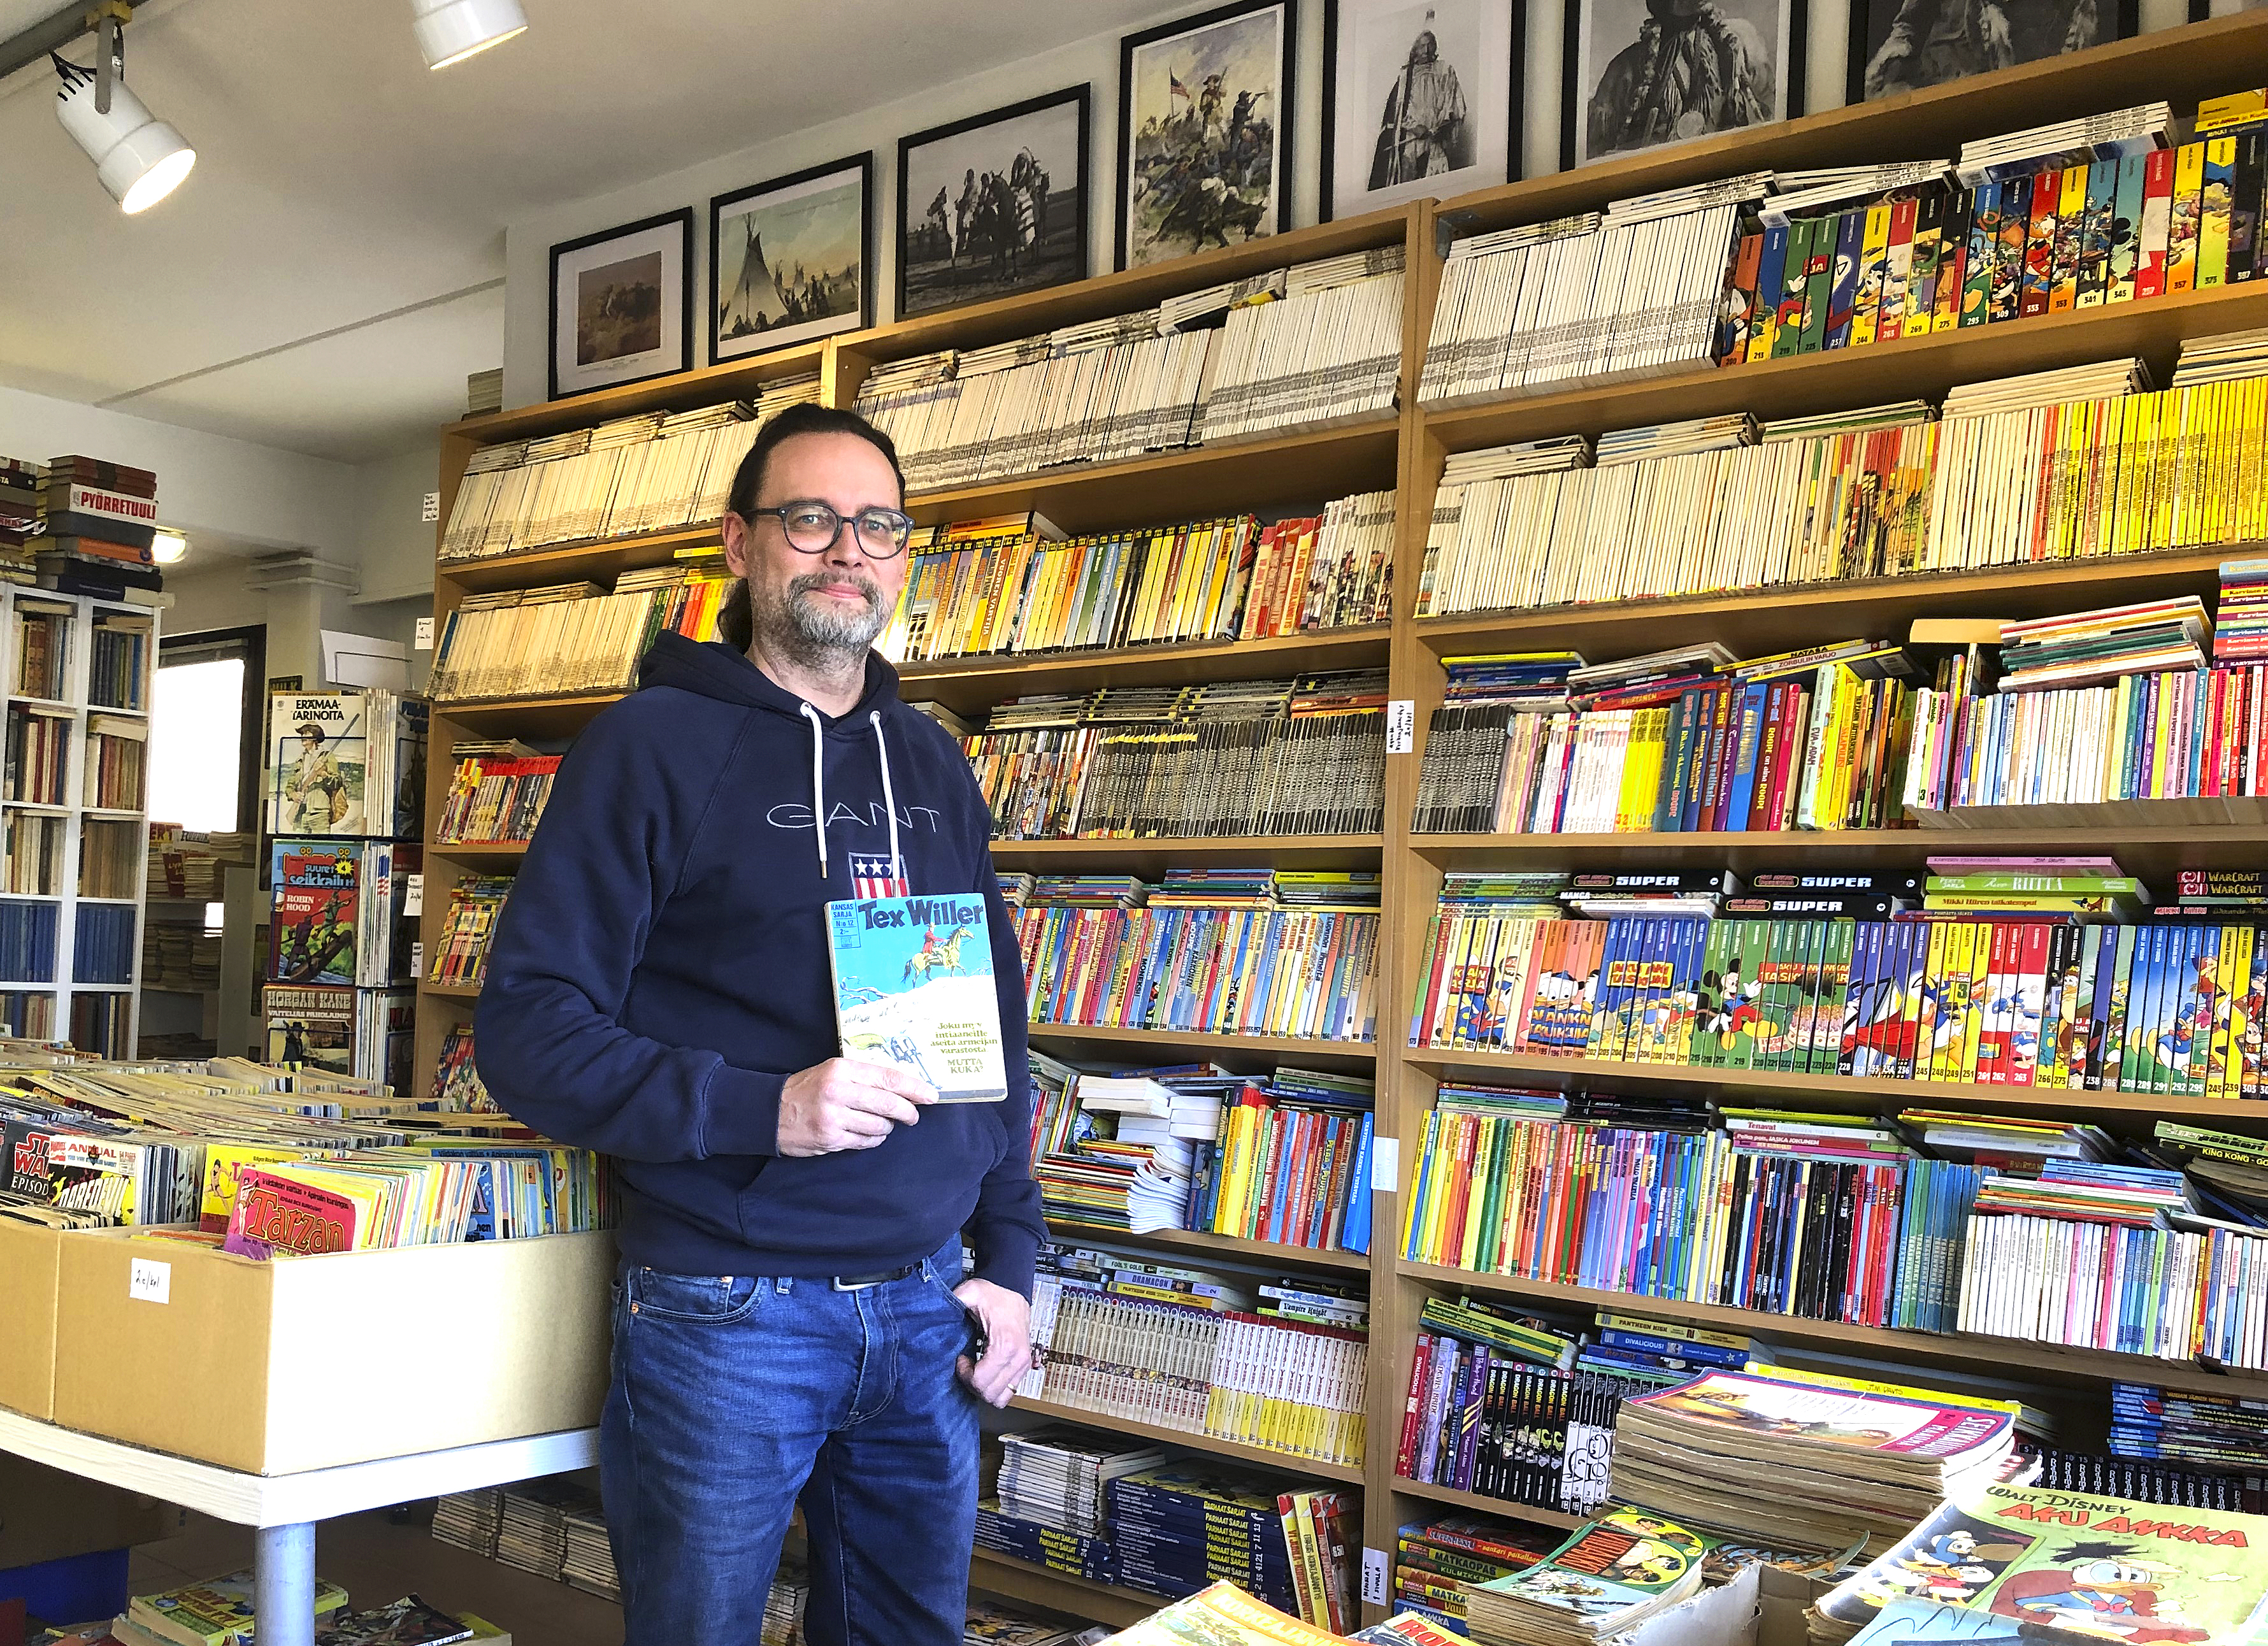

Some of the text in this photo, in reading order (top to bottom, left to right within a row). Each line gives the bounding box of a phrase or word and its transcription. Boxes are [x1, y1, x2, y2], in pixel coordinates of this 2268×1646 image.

[81, 490, 155, 520] PYÖRRETUULI
[296, 699, 341, 710] ERÄMAA-
[766, 801, 940, 833] GANT
[306, 865, 335, 873] suuret
[289, 874, 355, 887] seikkailut
[1616, 876, 1679, 885] SUPER
[1802, 877, 1872, 887] SUPER
[287, 895, 314, 904] ROBIN
[1772, 900, 1842, 912] SUPER
[858, 899, 984, 930] Tex Willer
[268, 991, 351, 1009] MORGAN KANE
[1626, 1050, 1636, 1059] 205
[1839, 1062, 1851, 1071] 228
[1916, 1067, 1928, 1075] 245
[1932, 1067, 1944, 1077] 248
[1946, 1068, 1959, 1078] 249
[1962, 1068, 1974, 1078] 251
[1992, 1071, 2006, 1082] 262
[2014, 1071, 2027, 1082] 263
[2038, 1074, 2051, 1084] 266
[2054, 1075, 2066, 1085] 273
[2086, 1075, 2100, 1086] 238
[2121, 1078, 2135, 1089] 289
[2137, 1079, 2151, 1089] 289
[2153, 1082, 2167, 1092] 291
[2172, 1082, 2186, 1092] 292
[2224, 1082, 2239, 1092] 239
[2242, 1084, 2257, 1094] 303
[1748, 1122, 1776, 1131] Tenavat
[2202, 1148, 2250, 1163] KING KONG
[246, 1187, 344, 1254] Tarzan
[1132, 1275, 1169, 1288] DRAMACON
[1284, 1303, 1328, 1317] Vampire Knight
[1470, 1301, 1491, 1313] DRAGON
[1625, 1338, 1664, 1349] DIVALICIOUS!
[1987, 1486, 2042, 1504] WALT
[1997, 1503, 2248, 1548] AKU ANKKA
[1435, 1552, 1496, 1576] MATKAOPAS
